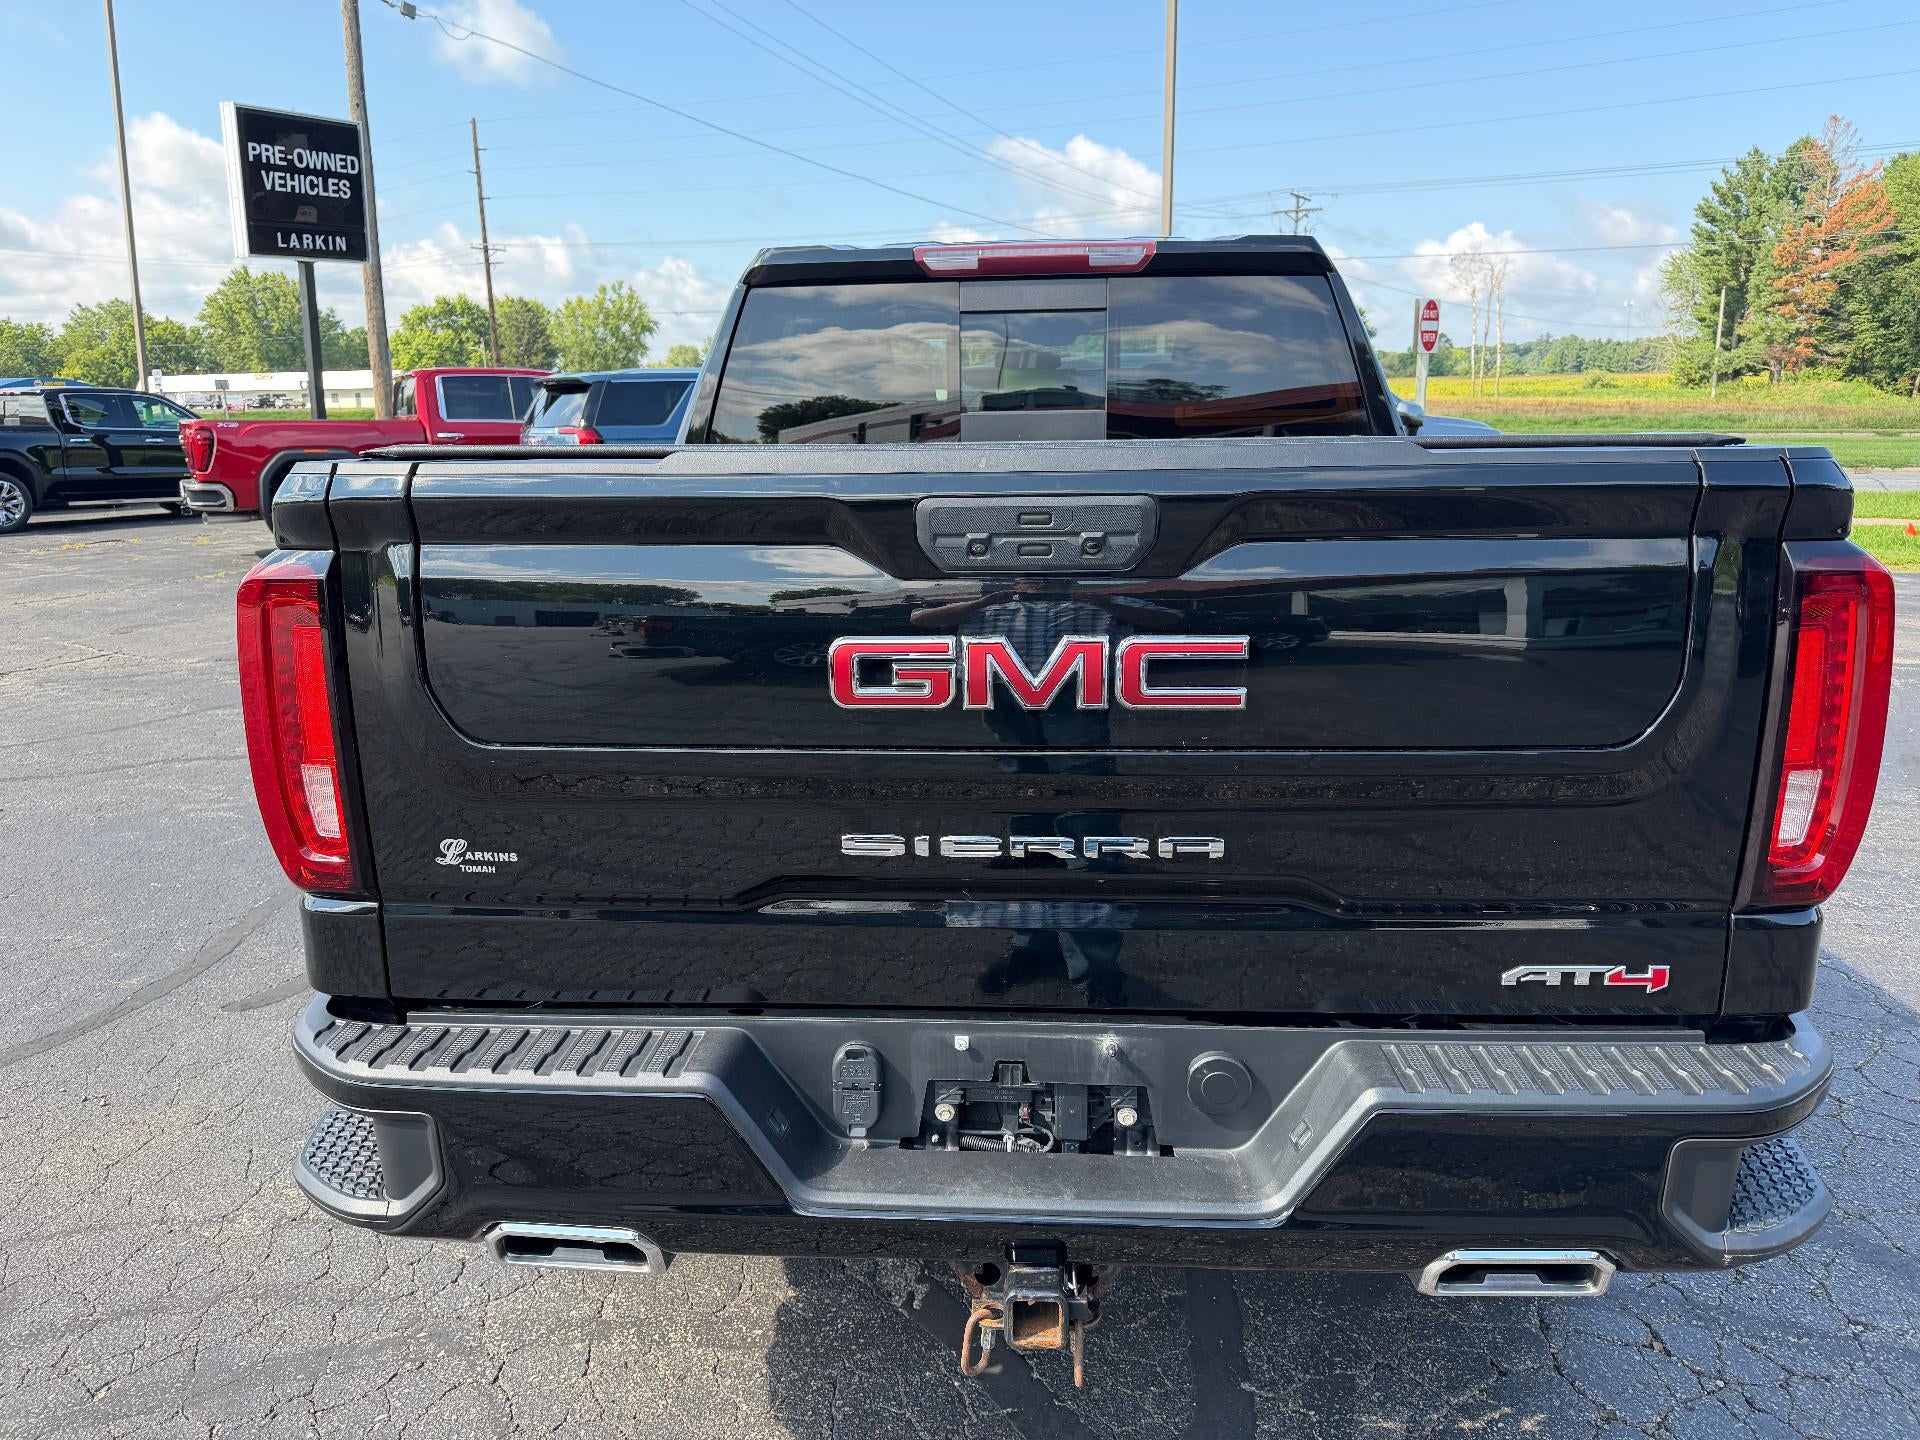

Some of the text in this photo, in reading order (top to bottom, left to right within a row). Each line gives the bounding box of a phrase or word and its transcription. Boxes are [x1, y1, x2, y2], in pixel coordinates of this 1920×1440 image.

[247, 142, 359, 175] PRE-OWNED
[260, 170, 352, 199] VEHICLES
[277, 231, 347, 252] LARKIN
[1423, 310, 1438, 318] DO NOT
[1423, 333, 1436, 342] ENTER
[828, 634, 1250, 711] GMC
[435, 838, 518, 865] LARKINS
[840, 833, 1225, 859] SIERRA
[459, 864, 496, 873] TOMAH
[1501, 965, 1670, 994] AT4
